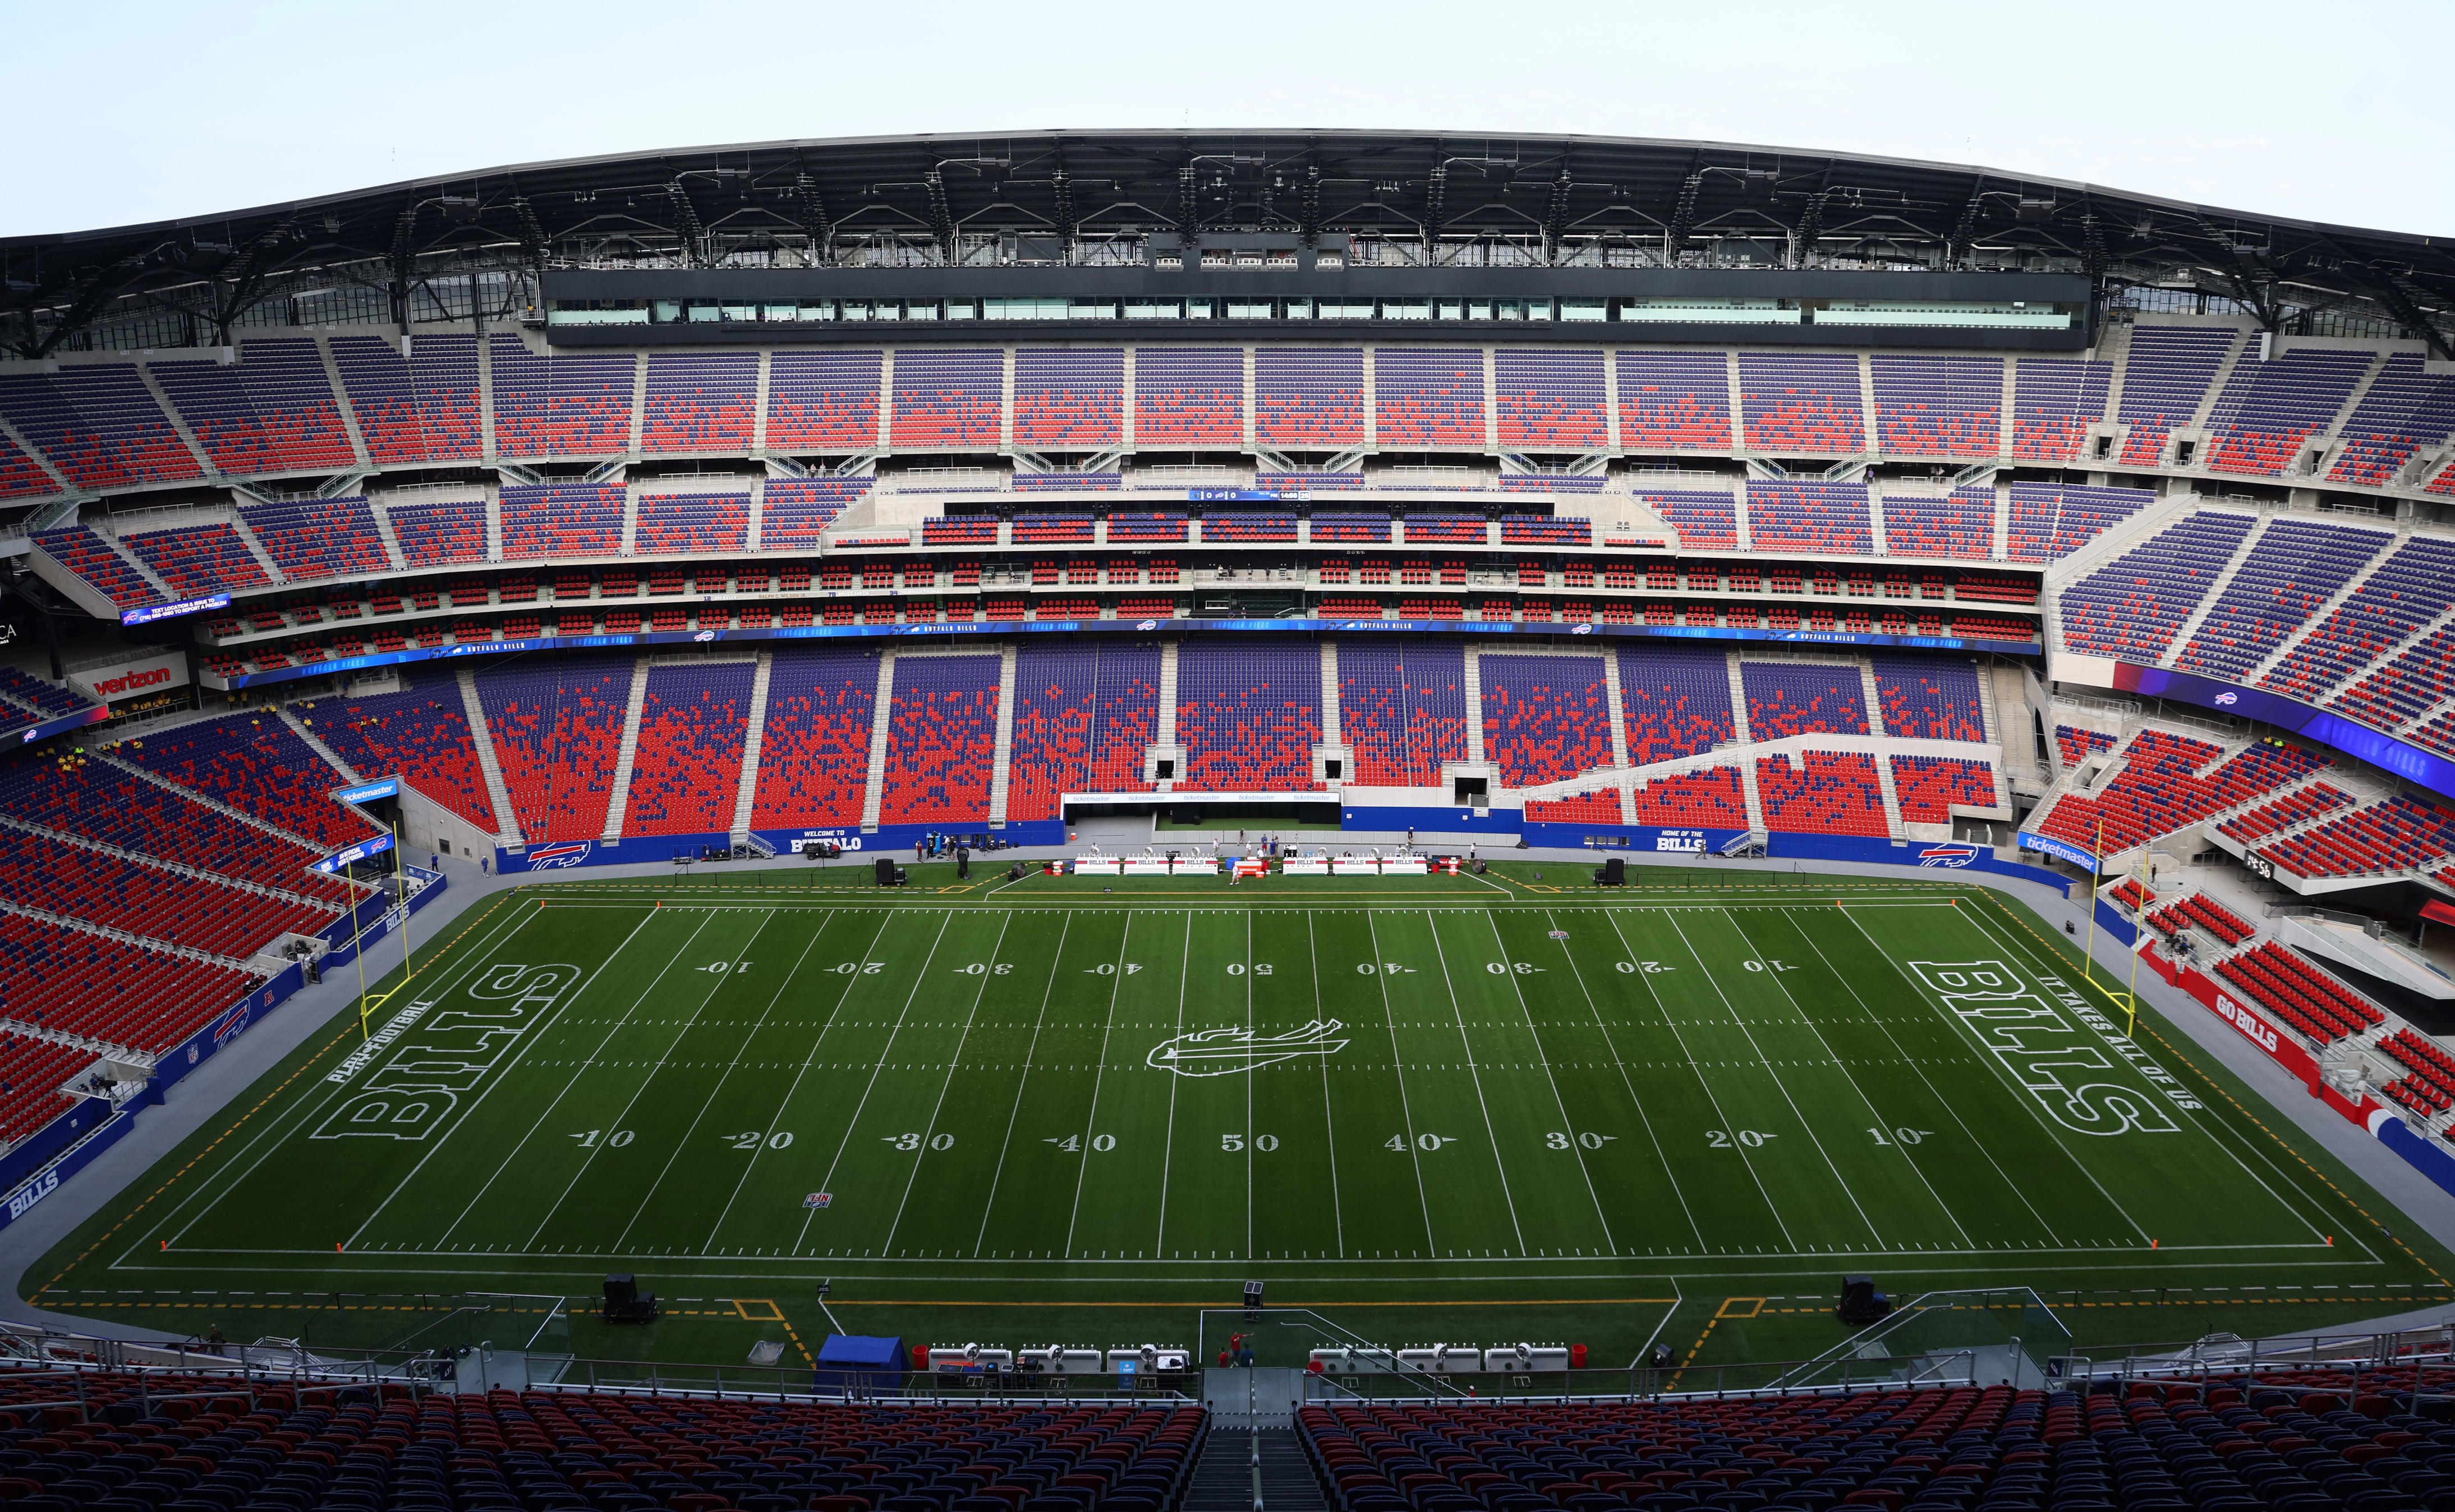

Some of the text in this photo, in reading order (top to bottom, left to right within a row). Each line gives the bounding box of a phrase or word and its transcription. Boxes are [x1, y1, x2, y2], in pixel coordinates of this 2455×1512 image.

[164, 603, 189, 611] LOCATION
[94, 667, 171, 695] verizon
[1657, 837, 1707, 852] BILLS
[2026, 836, 2094, 870] ticketmaster
[385, 904, 410, 933] BILLS
[364, 1001, 433, 1050] FOOTBALL
[2217, 994, 2278, 1053] GO BILLS
[309, 964, 581, 1140] BILLS
[1907, 961, 2182, 1137] BILLS
[2038, 977, 2203, 1110] IT TAKES ALL OF US
[578, 1130, 635, 1147] 10
[732, 1132, 794, 1149] 20
[895, 1133, 954, 1150] 30
[1058, 1134, 1116, 1151] 40
[1221, 1134, 1279, 1151] 50
[1384, 1134, 1441, 1151] 40
[1546, 1132, 1603, 1150] 30
[1705, 1130, 1764, 1147] 20
[1866, 1127, 1921, 1145] 10
[9, 1170, 58, 1220] BILLS
